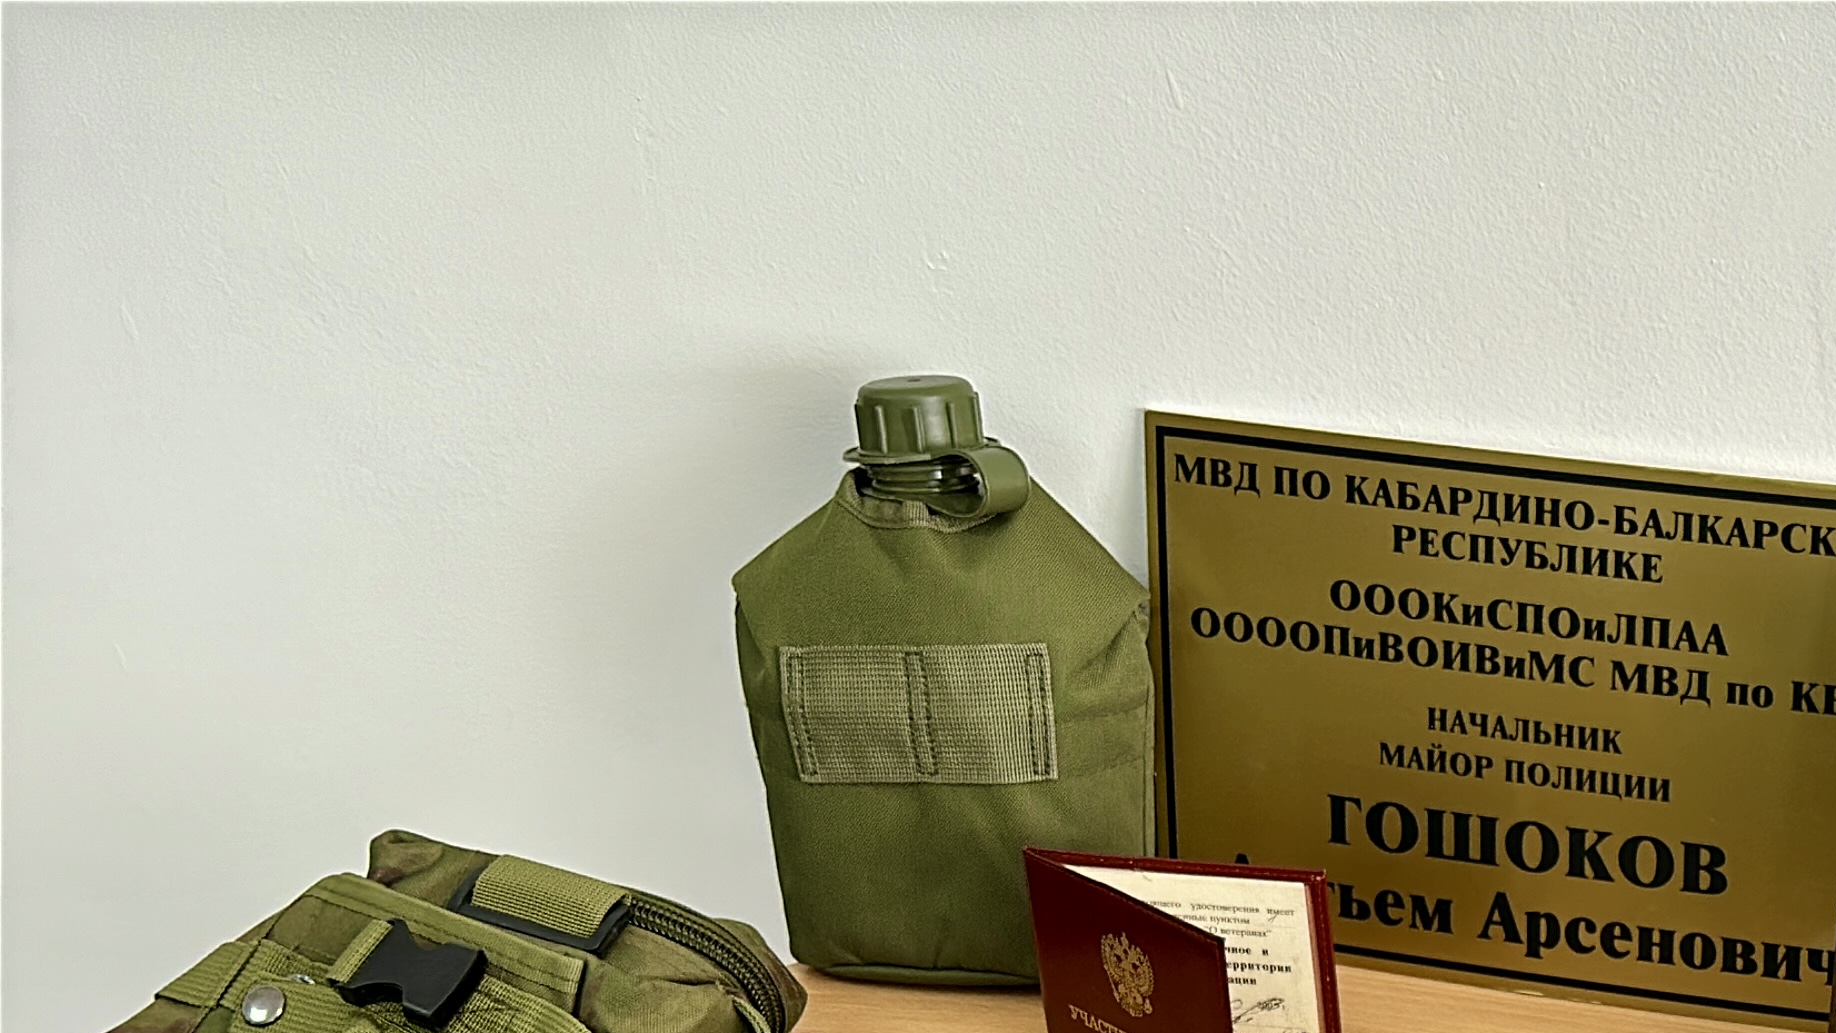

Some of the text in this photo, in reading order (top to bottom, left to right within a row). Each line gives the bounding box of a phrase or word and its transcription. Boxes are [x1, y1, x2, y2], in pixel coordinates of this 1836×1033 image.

[1174, 453, 1261, 498] МВД
[1273, 466, 1331, 500] ПО
[1392, 524, 1664, 584] РЕСПУБЛИКЕ
[1329, 579, 1729, 657] ОООКиСПОиЛПАА
[1190, 607, 1595, 688] ООООПиВОИВиМС
[1610, 660, 1711, 707] МВД
[1726, 682, 1775, 709] по
[1427, 706, 1623, 755] НАЧАЛЬНИК
[1379, 741, 1671, 803] МАЙОР ПОЛИЦИИ
[1327, 794, 1729, 896] ГОШОКОВ
[1226, 962, 1292, 974] ерритории
[1477, 891, 1836, 986] Арсенович
